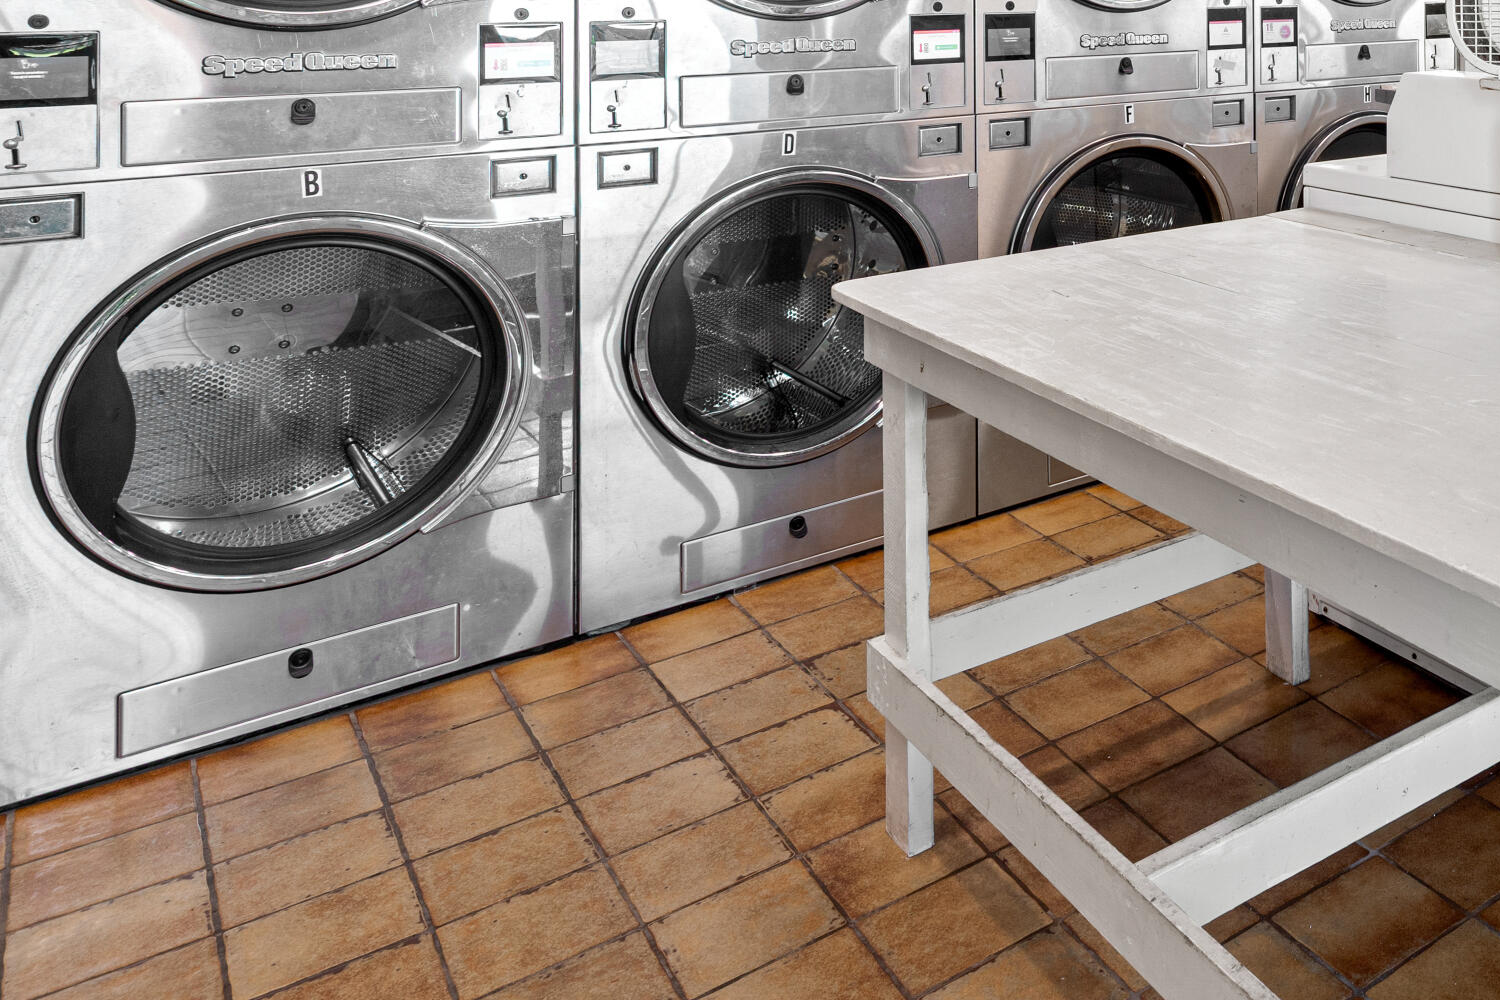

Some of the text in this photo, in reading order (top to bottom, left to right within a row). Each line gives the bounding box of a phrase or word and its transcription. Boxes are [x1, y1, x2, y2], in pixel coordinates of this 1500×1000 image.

[730, 37, 856, 58] Speed Queen
[1080, 32, 1168, 50] Speed Queen
[202, 52, 398, 78] Speed Queen
[1364, 87, 1371, 102] H
[1125, 105, 1132, 122] F
[784, 133, 794, 155] D
[304, 170, 320, 196] B
